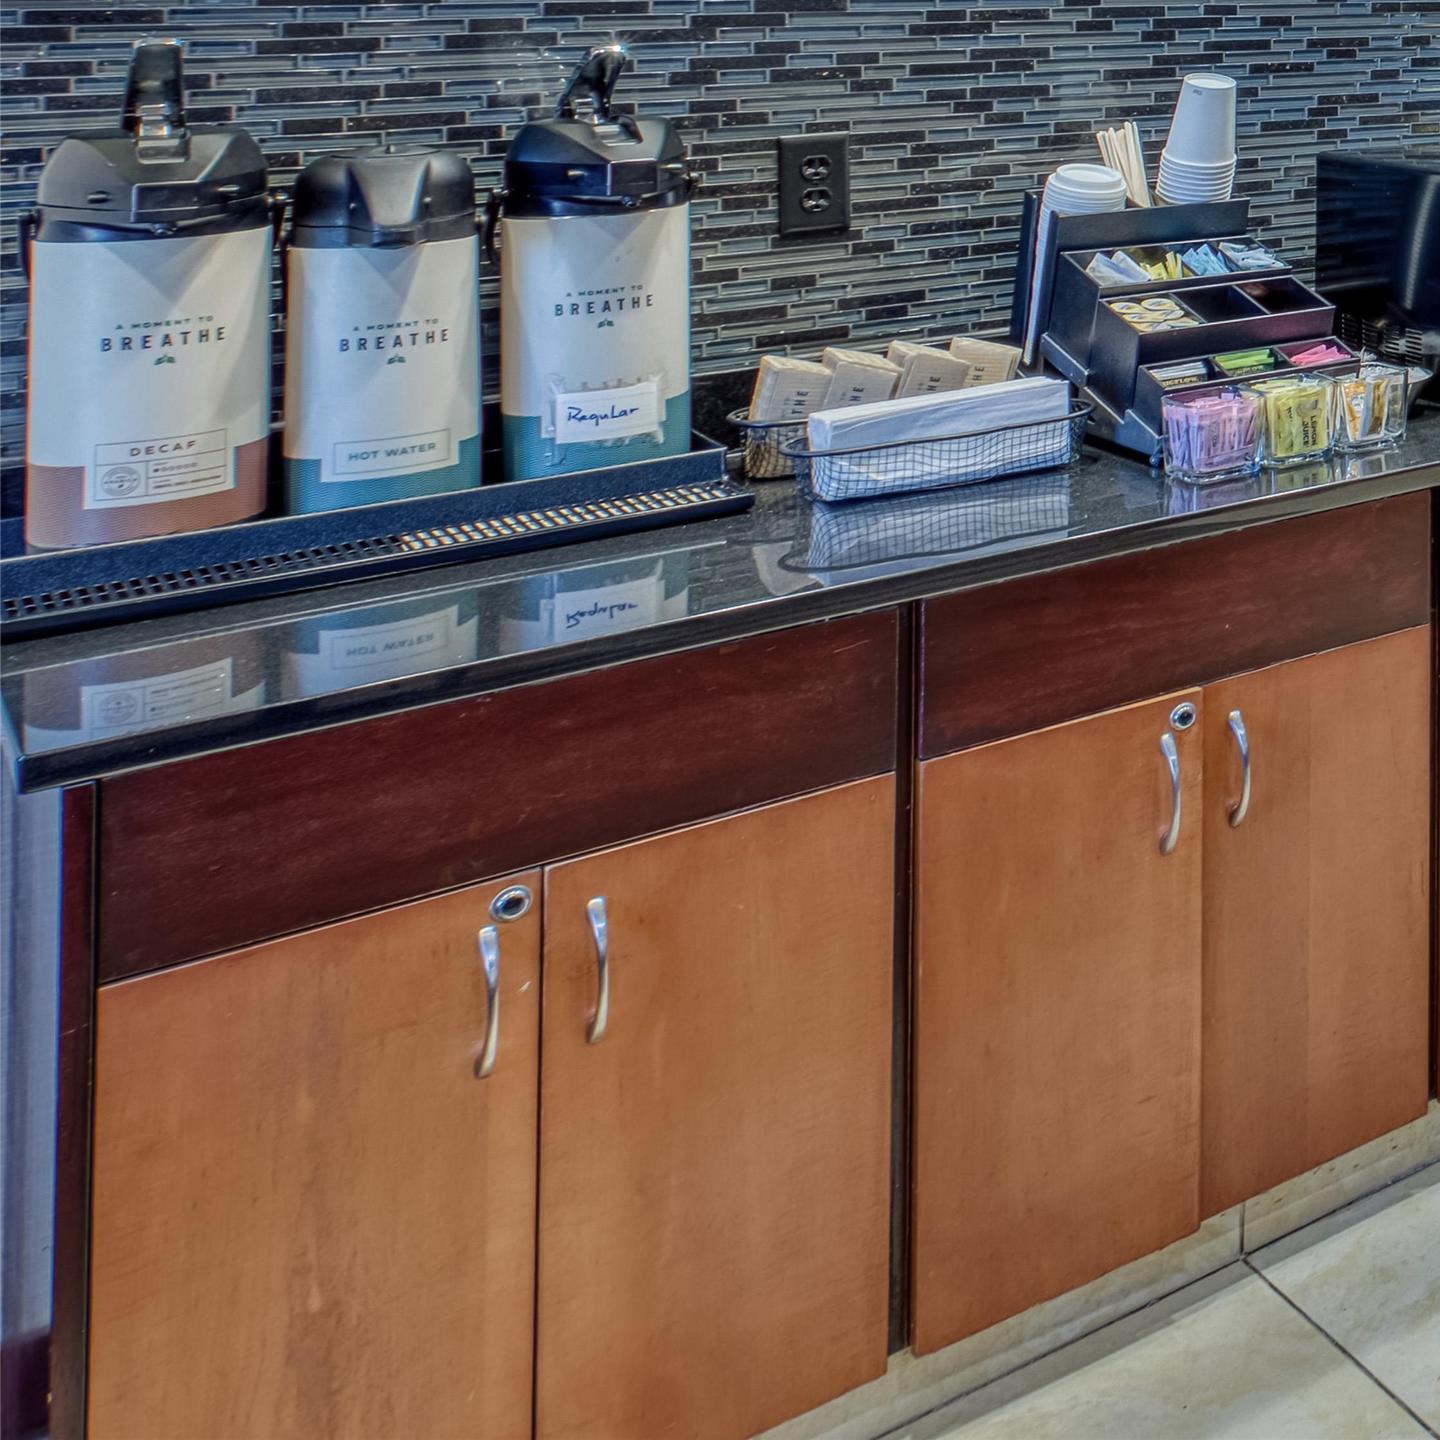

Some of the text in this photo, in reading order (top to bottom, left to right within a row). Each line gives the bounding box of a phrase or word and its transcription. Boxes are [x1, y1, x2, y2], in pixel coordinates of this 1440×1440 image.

[578, 287, 626, 296] MOMENT
[554, 294, 655, 317] BREATHE
[131, 318, 191, 329] MOMENT
[198, 315, 214, 323] TO
[366, 320, 420, 330] MOMENT
[100, 326, 226, 352] BREATHE
[338, 328, 449, 353] BREATHE
[1302, 420, 1310, 447] JUICE
[1310, 415, 1318, 446] LEMON
[129, 440, 197, 457] DECAF
[348, 442, 437, 462] HOT WATER
